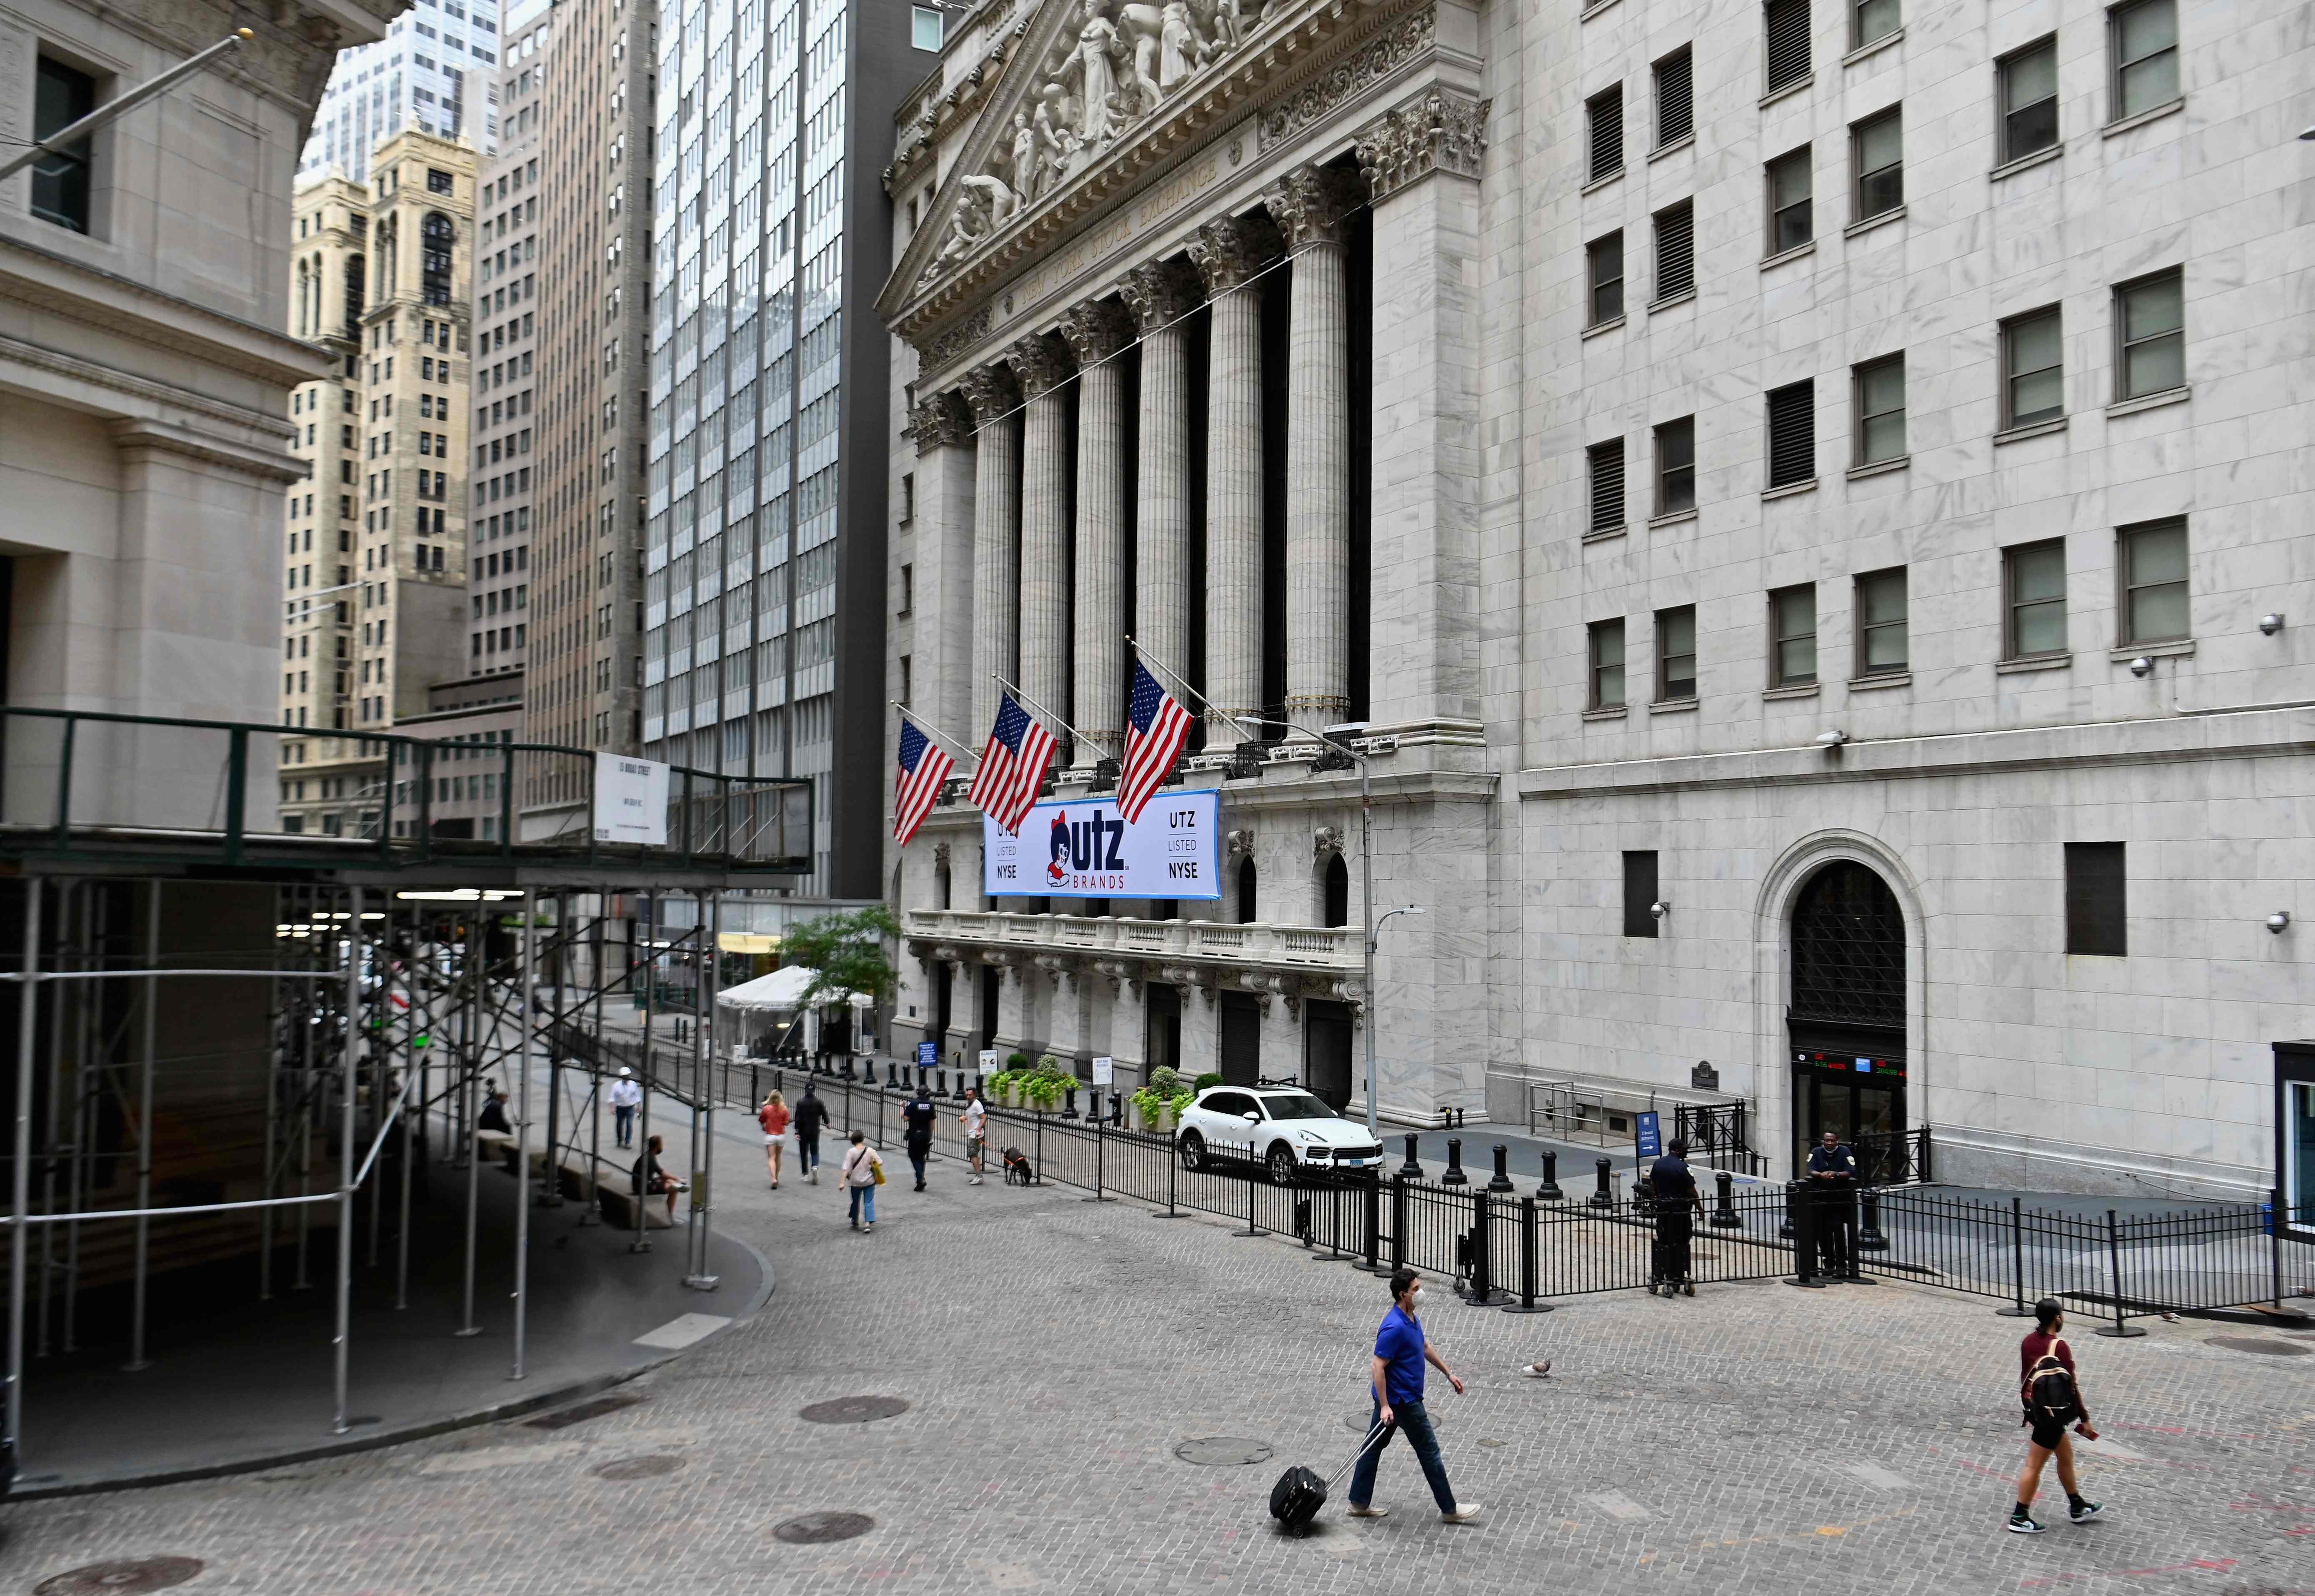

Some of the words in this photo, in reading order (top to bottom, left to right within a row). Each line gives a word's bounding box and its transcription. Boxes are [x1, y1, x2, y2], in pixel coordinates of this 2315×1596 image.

[1023, 272, 1047, 304] NEW
[1053, 247, 1084, 284] YORK
[1091, 215, 1131, 258] STOCK
[1140, 157, 1217, 227] EXCHANGE
[1170, 811, 1195, 828] UTZ
[997, 846, 1016, 856] LISTED
[1169, 840, 1196, 851] LISTED
[997, 865, 1016, 878] NYSE
[1169, 863, 1198, 878] NYSE
[1074, 875, 1124, 889] BRANDS
